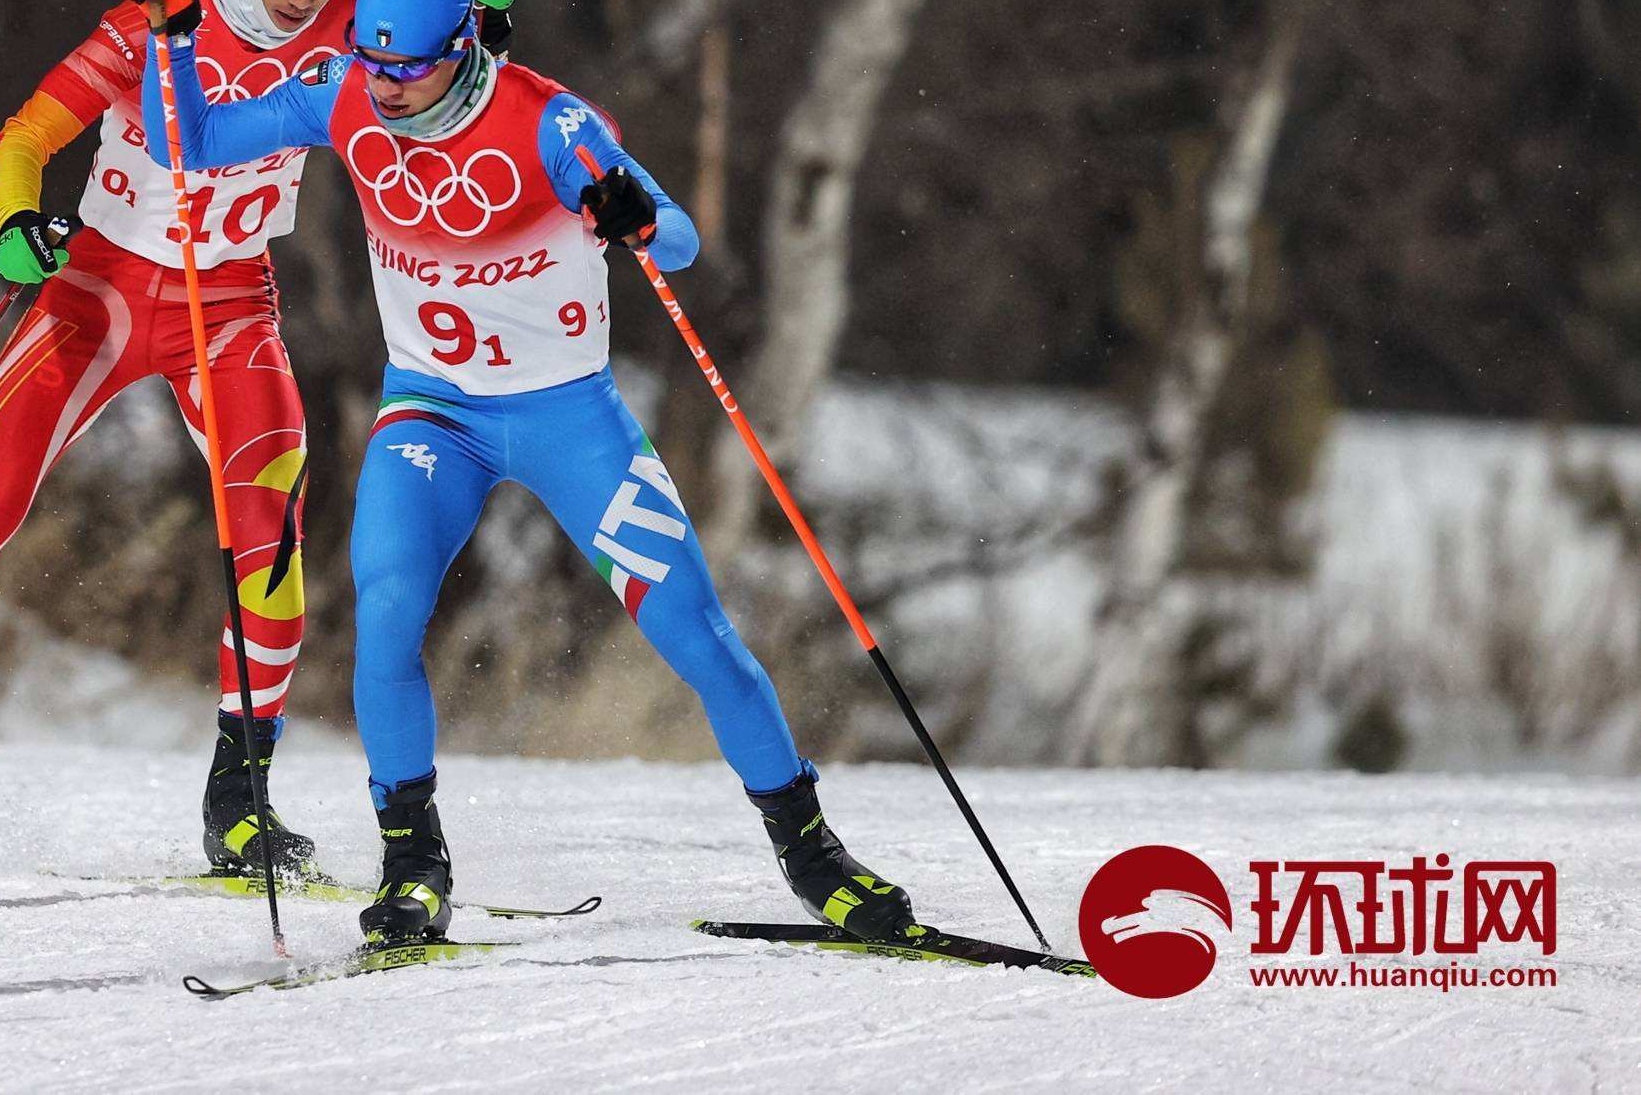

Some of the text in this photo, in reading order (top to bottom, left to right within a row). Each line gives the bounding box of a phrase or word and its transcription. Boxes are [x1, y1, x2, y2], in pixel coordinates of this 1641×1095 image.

[166, 184, 281, 245] 10
[366, 227, 560, 288] EIJING 2022
[380, 828, 413, 837] HER
[384, 947, 427, 966] FISCHER
